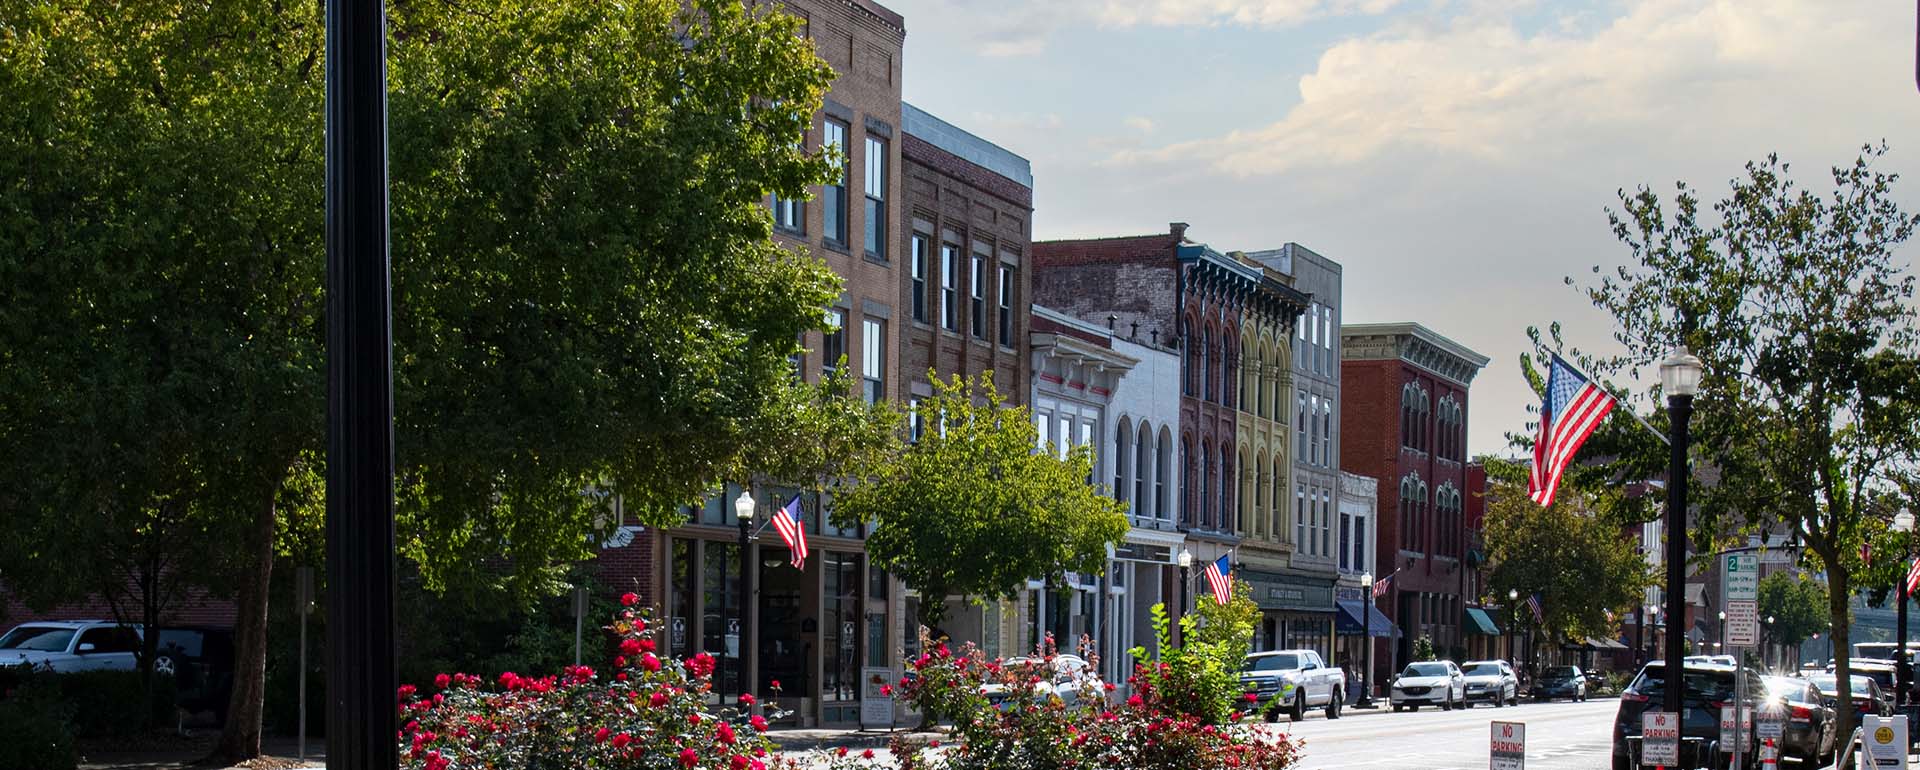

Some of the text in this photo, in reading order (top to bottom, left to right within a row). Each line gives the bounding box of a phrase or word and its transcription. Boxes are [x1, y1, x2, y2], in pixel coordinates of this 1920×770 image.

[1729, 559, 1736, 569] 2
[1655, 716, 1665, 726] NO
[1503, 725, 1513, 738] NO
[1645, 729, 1676, 738] PARKING
[1492, 740, 1523, 752] PARKING
